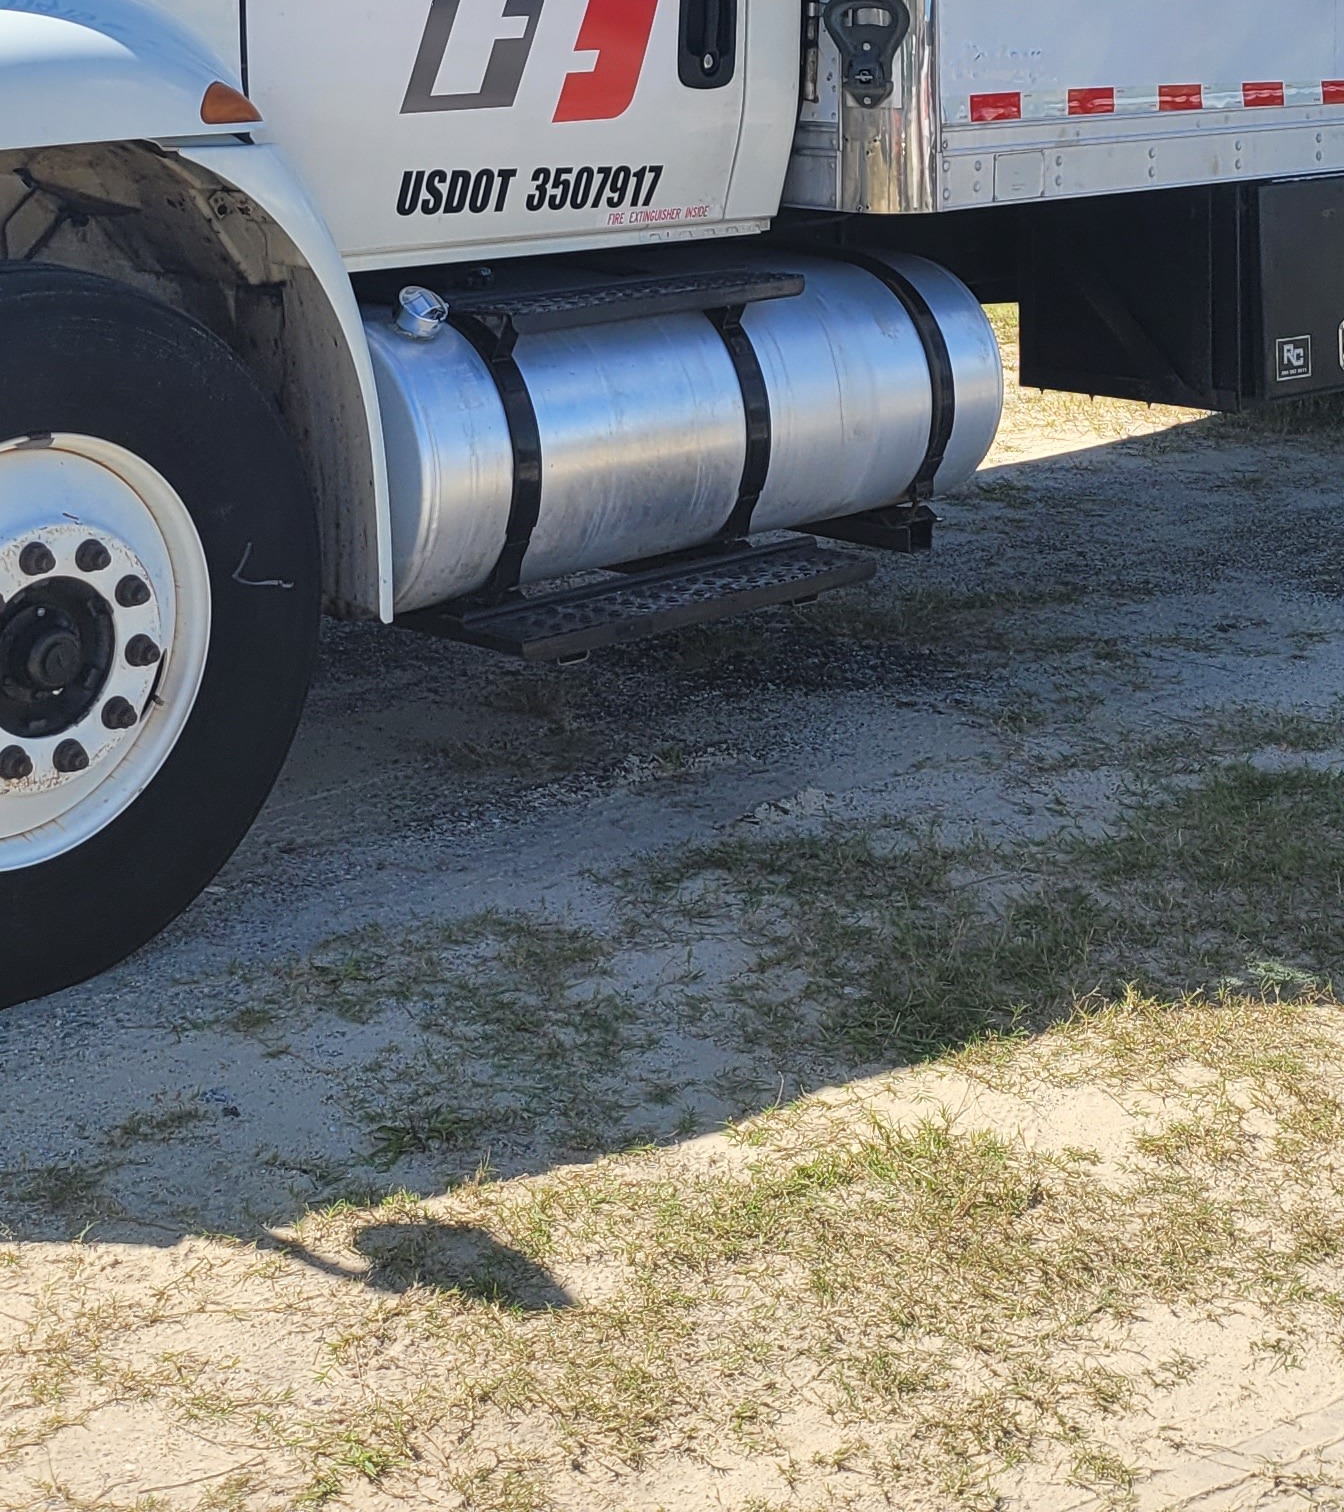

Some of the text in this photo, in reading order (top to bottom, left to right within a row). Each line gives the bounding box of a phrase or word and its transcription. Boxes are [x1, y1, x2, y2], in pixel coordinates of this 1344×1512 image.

[396, 165, 664, 216] USDOT 3507917
[607, 205, 710, 226] FIRE EXTINGUISHER INSIDE
[1283, 343, 1305, 367] RC
